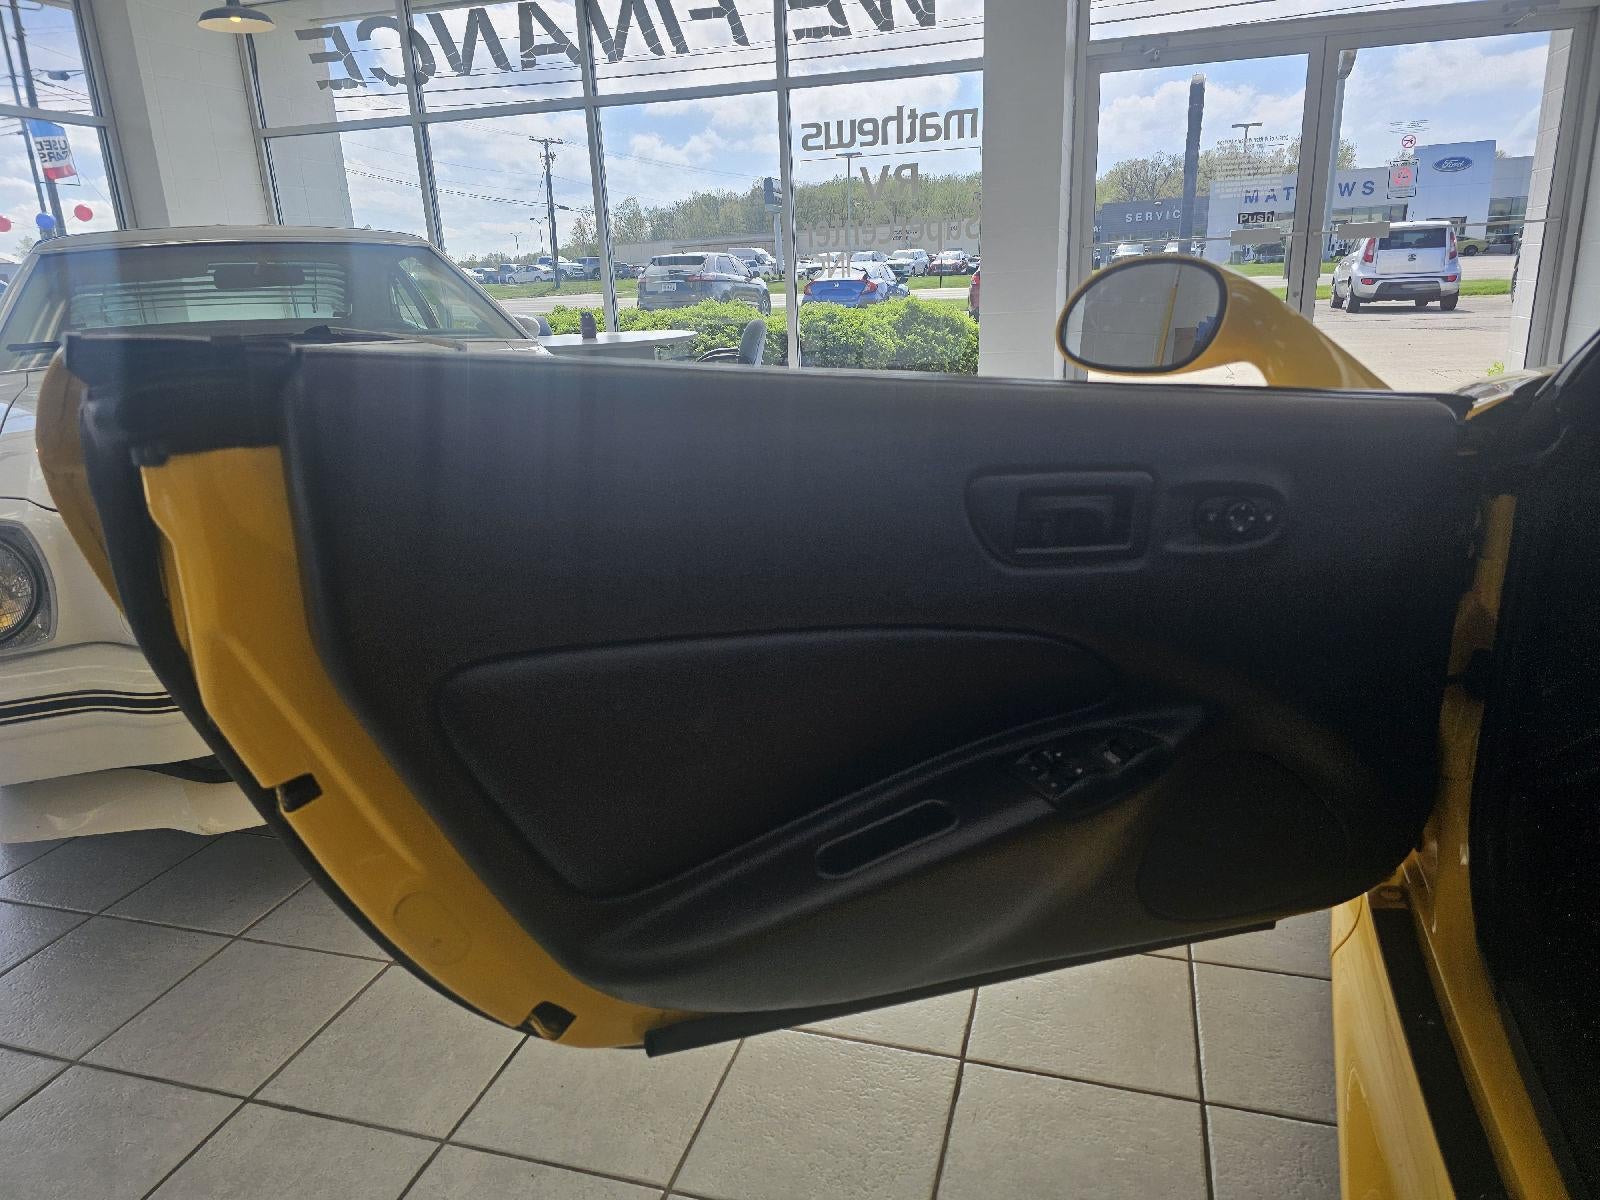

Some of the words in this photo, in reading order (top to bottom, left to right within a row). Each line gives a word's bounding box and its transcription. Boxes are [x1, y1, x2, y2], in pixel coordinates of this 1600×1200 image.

[1243, 183, 1375, 204] MATWS
[1125, 208, 1181, 223] SERVIC
[1239, 212, 1274, 224] Push
